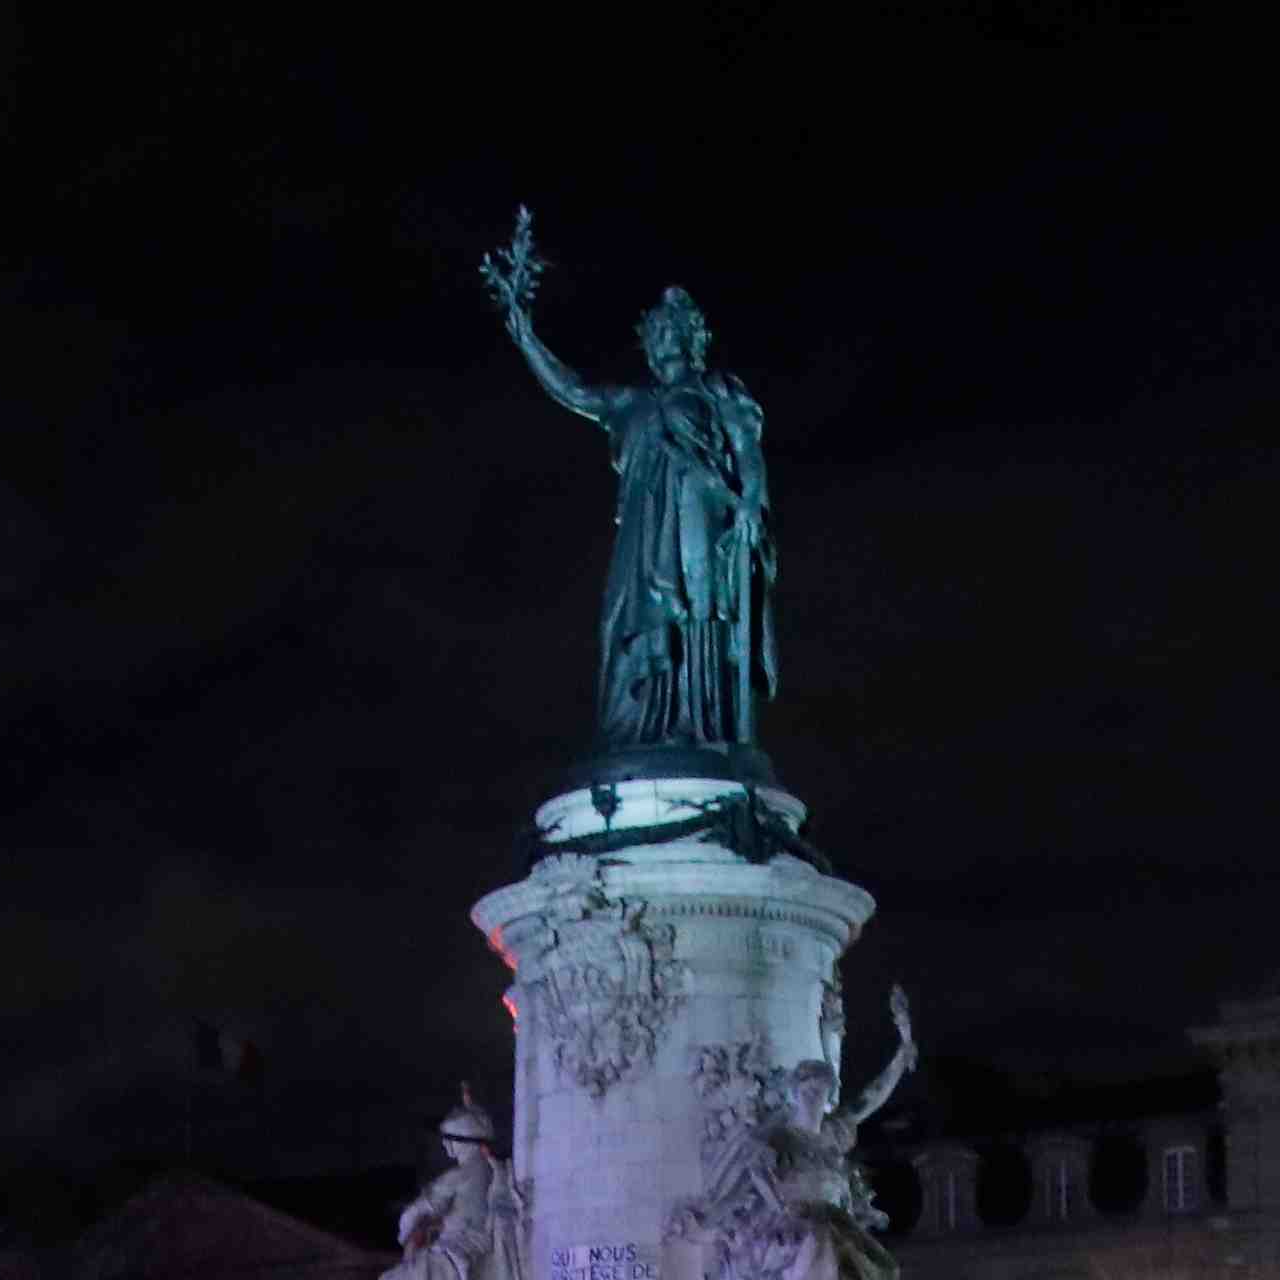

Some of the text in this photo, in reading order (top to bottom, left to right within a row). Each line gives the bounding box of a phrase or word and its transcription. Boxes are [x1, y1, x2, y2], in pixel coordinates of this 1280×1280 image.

[552, 1243, 637, 1267] QUI NOUS
[632, 1263, 657, 1280] DE
